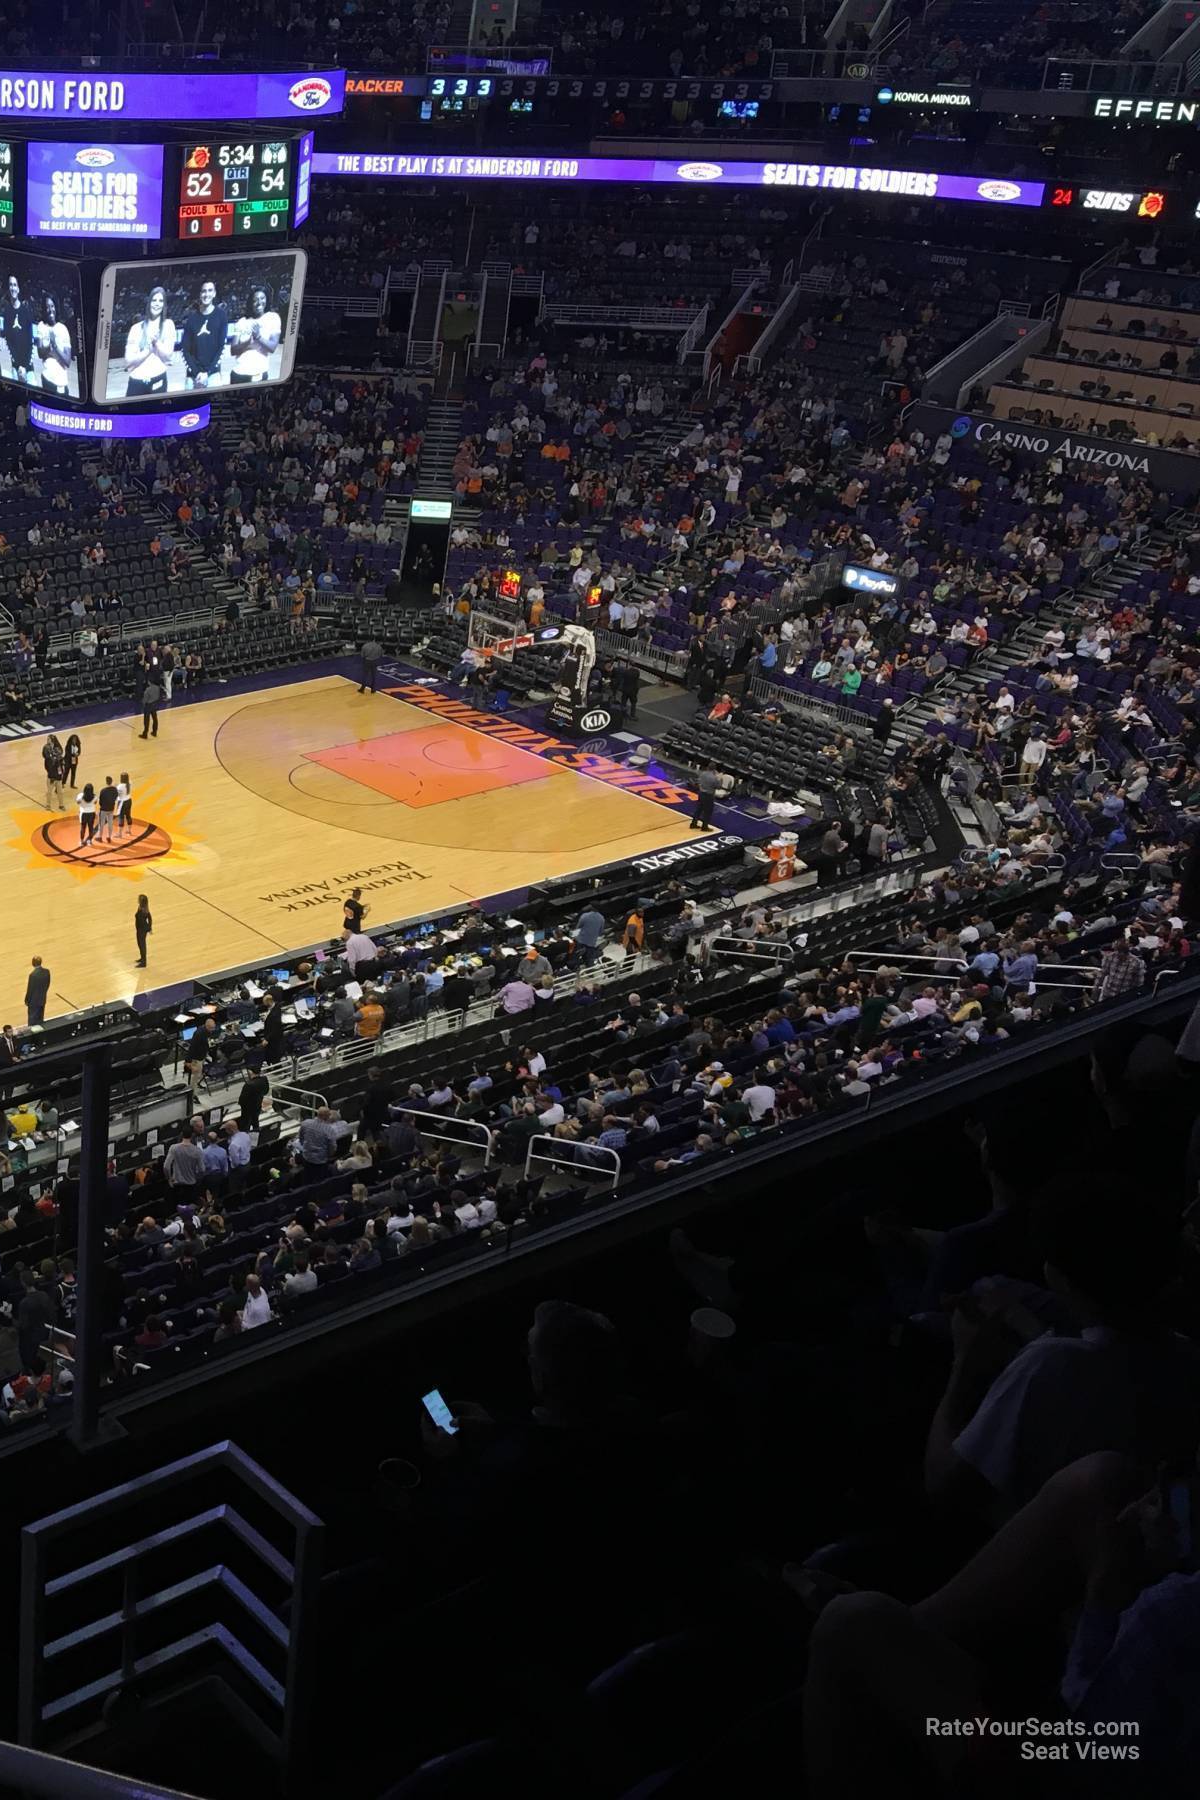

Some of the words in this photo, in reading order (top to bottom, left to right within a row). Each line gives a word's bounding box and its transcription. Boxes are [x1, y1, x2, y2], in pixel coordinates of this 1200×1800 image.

[64, 80, 125, 111] FORD
[431, 79, 445, 95] 3
[454, 79, 468, 95] 3
[477, 79, 491, 95] 3
[894, 91, 929, 104] KONICA
[931, 93, 971, 106] MINOLTA
[1095, 98, 1196, 121] EFFEN
[219, 145, 254, 165] 5:34
[227, 169, 247, 179] QTR
[338, 155, 360, 171] THE
[364, 156, 394, 172] BEST
[398, 157, 427, 174] PLAY
[432, 157, 444, 174] IS
[448, 158, 463, 174] AT
[467, 158, 541, 176] SANDERSON
[544, 160, 578, 177] FORD
[52, 171, 103, 195] SEATS
[106, 172, 138, 196] FOR
[187, 173, 212, 197] 52
[231, 183, 239, 196] 3
[261, 169, 285, 191] 54
[763, 163, 820, 187] SEATS
[823, 166, 857, 189] FOR
[859, 168, 938, 197] SOLDIERS
[51, 194, 138, 220] SOLDIERS
[240, 203, 254, 212] TOL
[263, 200, 287, 210] FOULS
[1052, 189, 1073, 205] 24
[1083, 191, 1134, 211] SUNS
[181, 206, 207, 216] FOULS
[214, 204, 229, 214] TOL
[1, 214, 7, 228] 0
[191, 219, 199, 233] 0
[214, 218, 222, 231] 5
[243, 216, 251, 229] 5
[270, 214, 278, 227] 0
[289, 302, 299, 337] verizon
[44, 412, 86, 430] SANDERSON
[89, 418, 113, 431] FORD
[975, 423, 1050, 454] CASINO
[1053, 438, 1150, 474] ARIZONA
[503, 579, 518, 596] 24
[858, 575, 896, 594] PayPal
[585, 713, 606, 729] KIA
[380, 685, 576, 753] PHOENIX
[552, 751, 699, 804] SUNS
[333, 861, 413, 885] RESORT
[341, 870, 432, 894] TALKING
[259, 880, 330, 903] ARENA
[280, 893, 341, 912] STICK
